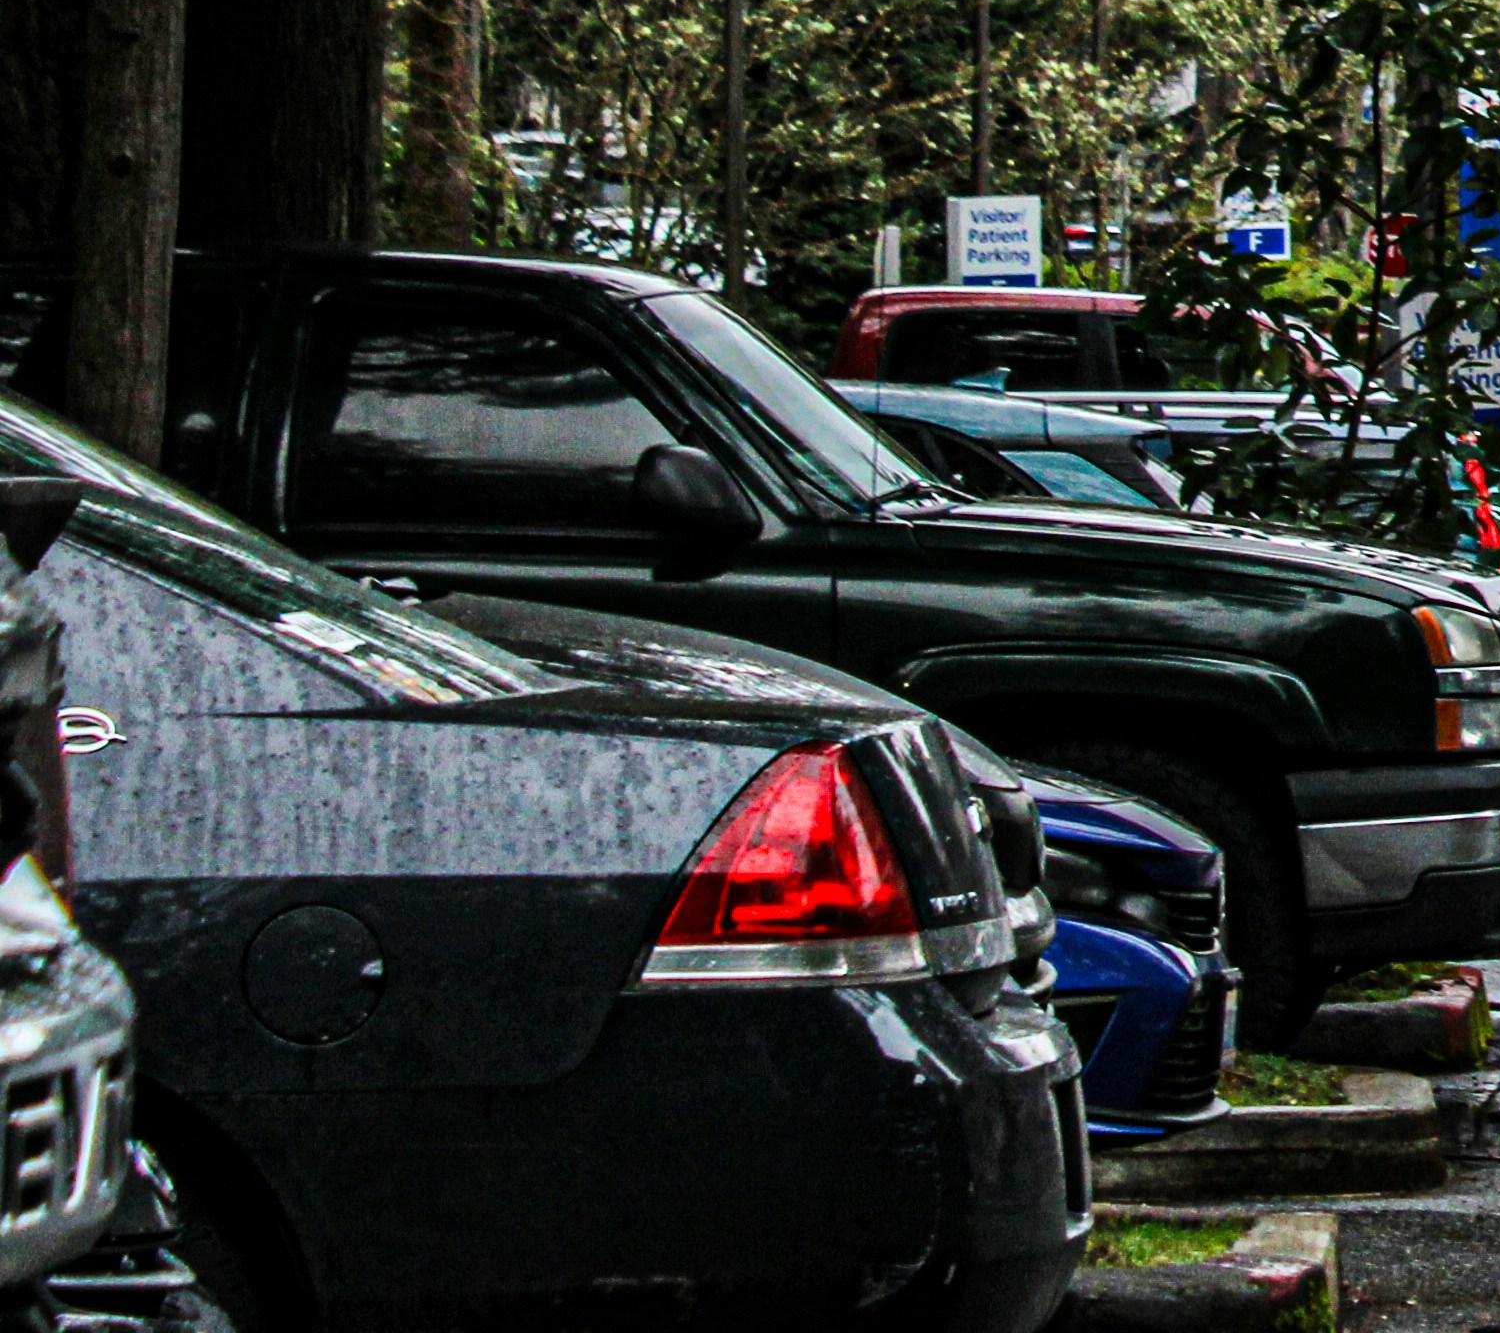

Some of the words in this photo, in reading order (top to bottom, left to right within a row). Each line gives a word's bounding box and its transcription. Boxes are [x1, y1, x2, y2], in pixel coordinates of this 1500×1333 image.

[968, 227, 1028, 244] Patient
[1248, 231, 1263, 253] F
[967, 247, 1031, 266] Parking
